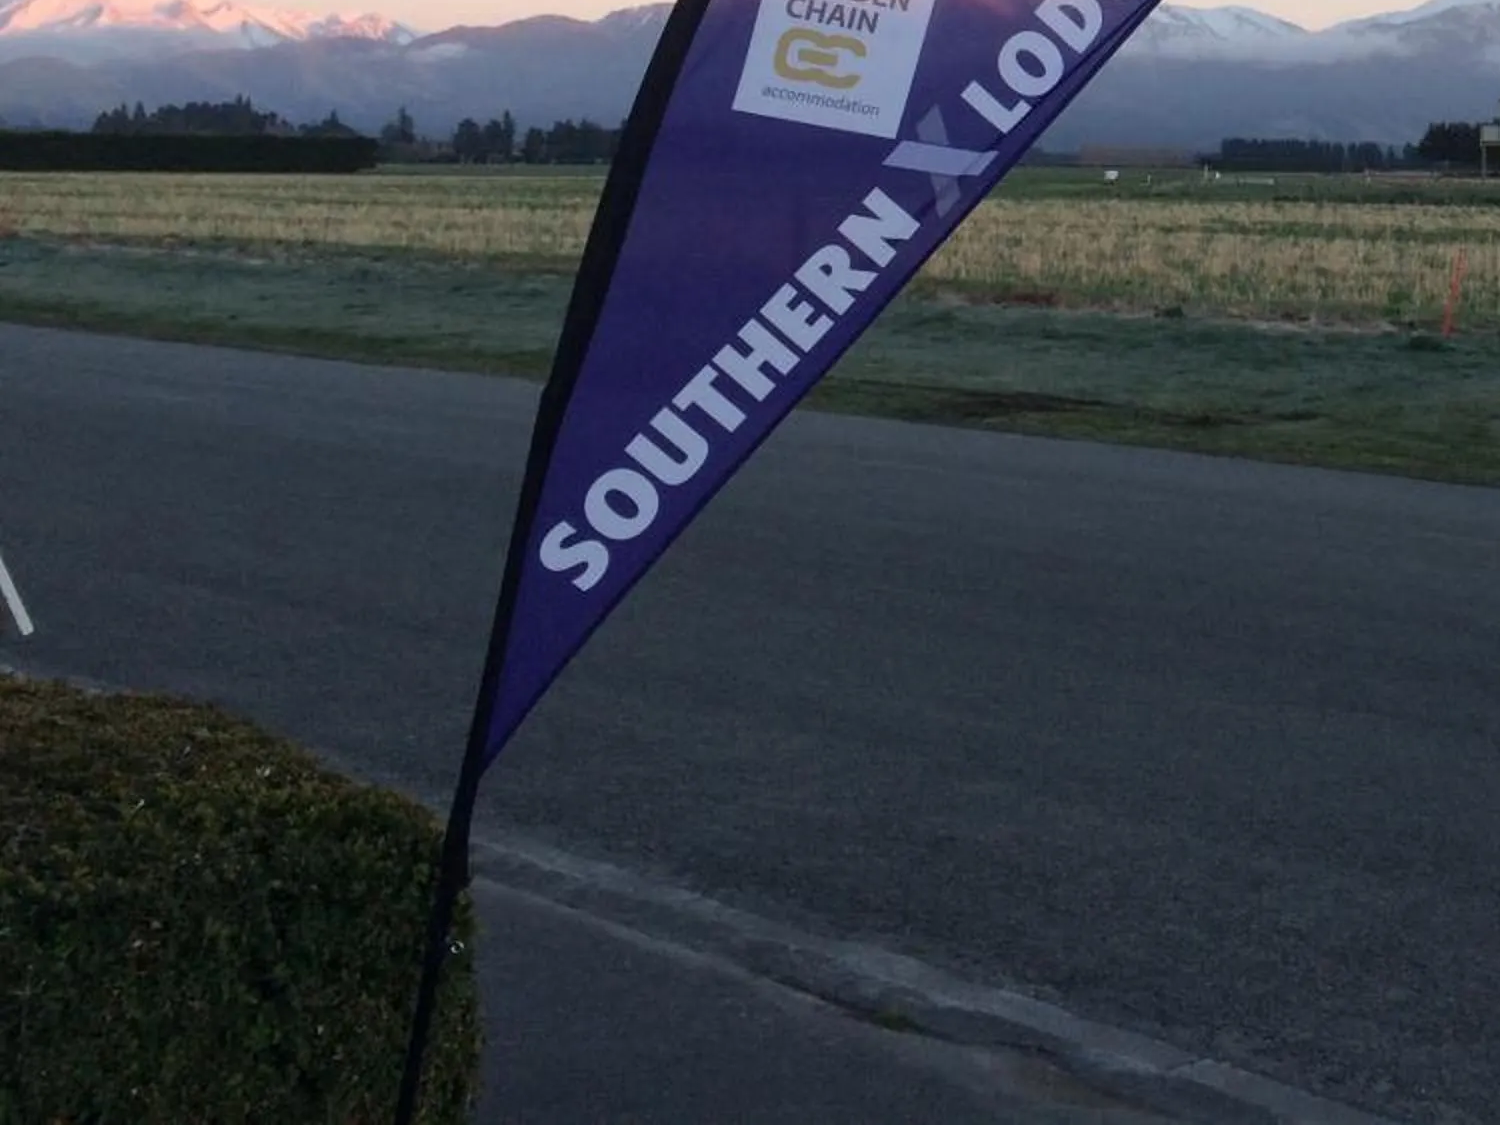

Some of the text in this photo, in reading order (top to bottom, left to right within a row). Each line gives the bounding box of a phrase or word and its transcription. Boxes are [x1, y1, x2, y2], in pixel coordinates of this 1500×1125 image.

[761, 84, 880, 117] accommodation
[539, 187, 920, 592] SOUTHERN
[882, 104, 999, 218] X
